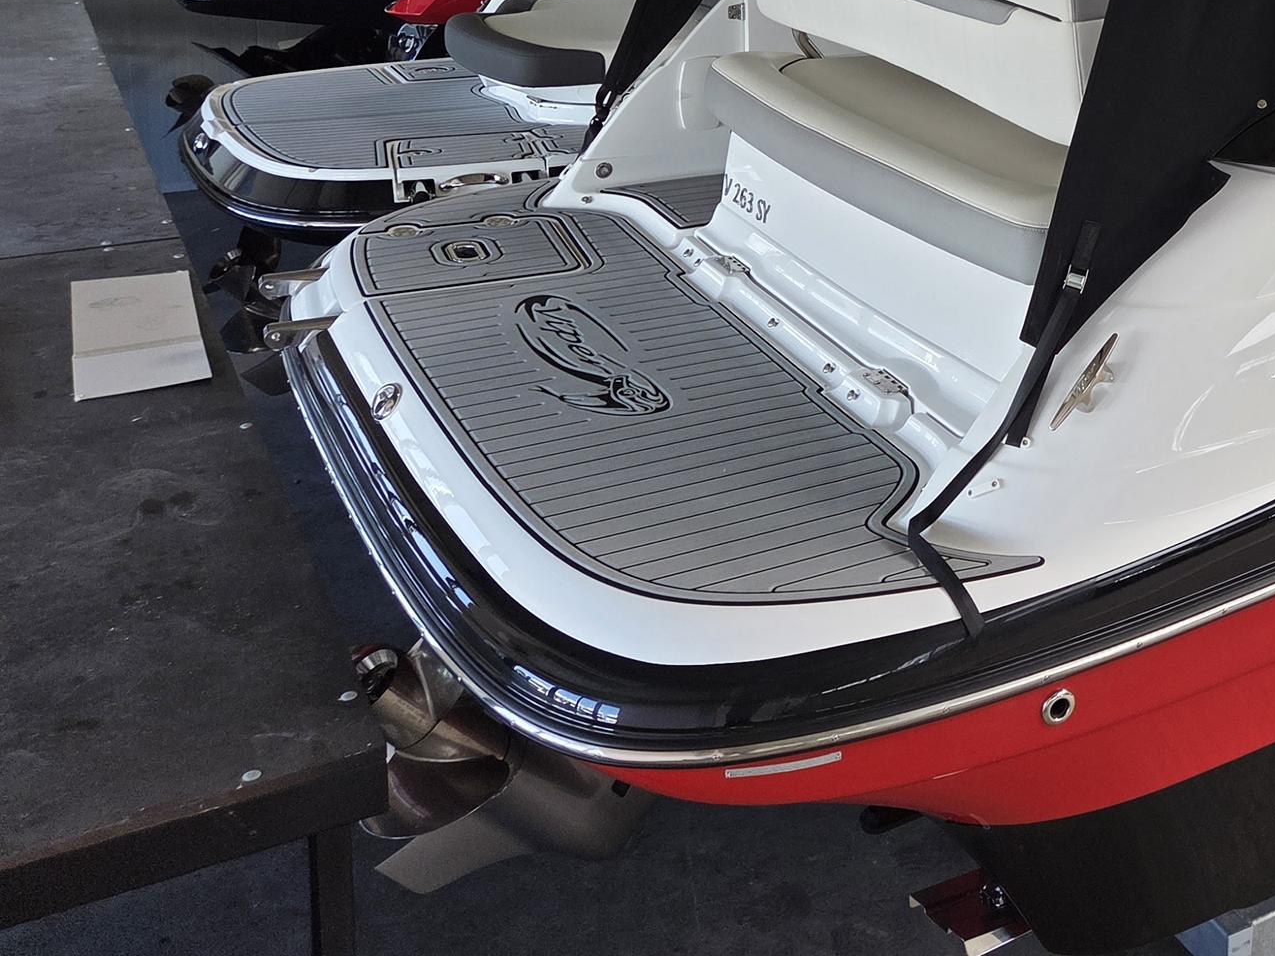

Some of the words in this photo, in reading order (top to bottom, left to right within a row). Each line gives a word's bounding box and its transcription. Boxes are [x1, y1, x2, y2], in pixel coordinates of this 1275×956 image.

[724, 173, 733, 196] V
[732, 182, 754, 214] 263
[756, 198, 771, 224] SY
